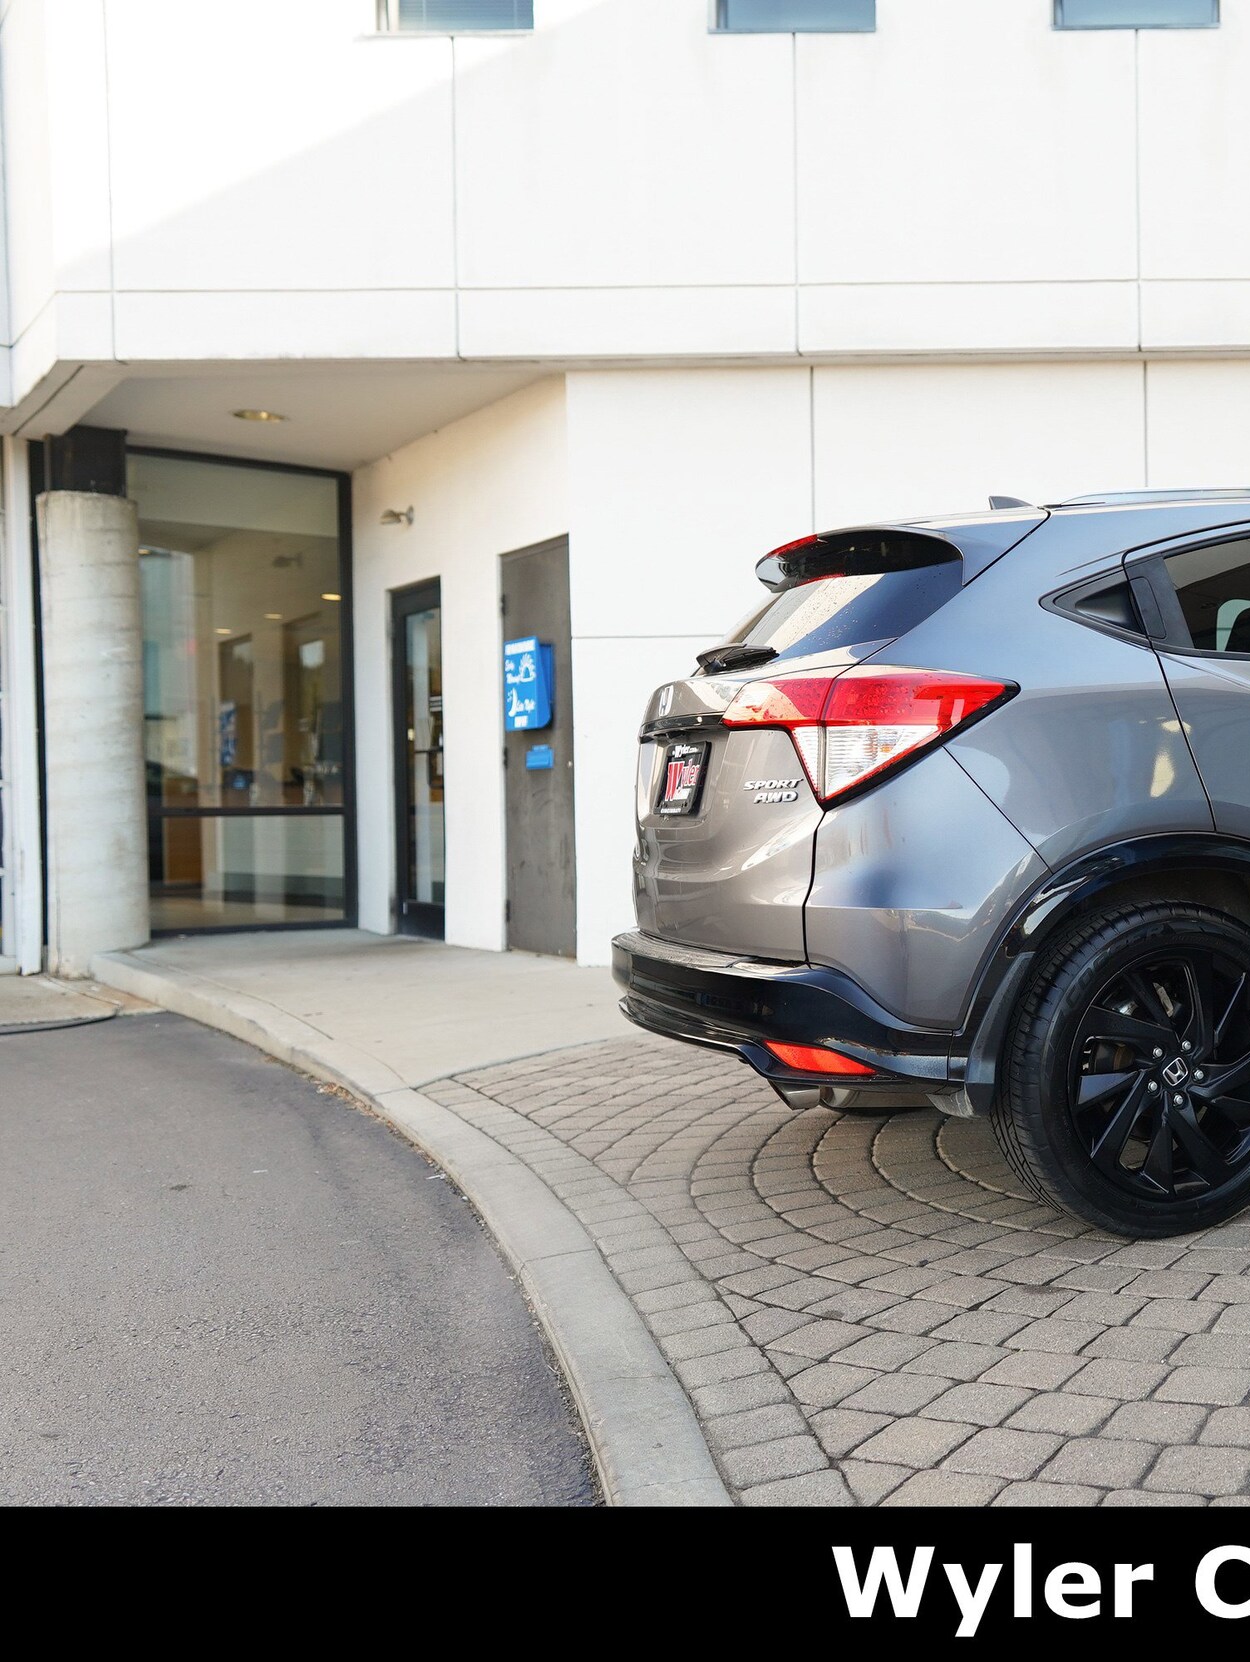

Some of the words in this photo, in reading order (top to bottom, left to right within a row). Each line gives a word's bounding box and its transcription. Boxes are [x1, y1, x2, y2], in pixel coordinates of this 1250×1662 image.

[665, 758, 700, 801] Wyler
[743, 778, 803, 790] SPORT
[753, 791, 798, 804] AWD
